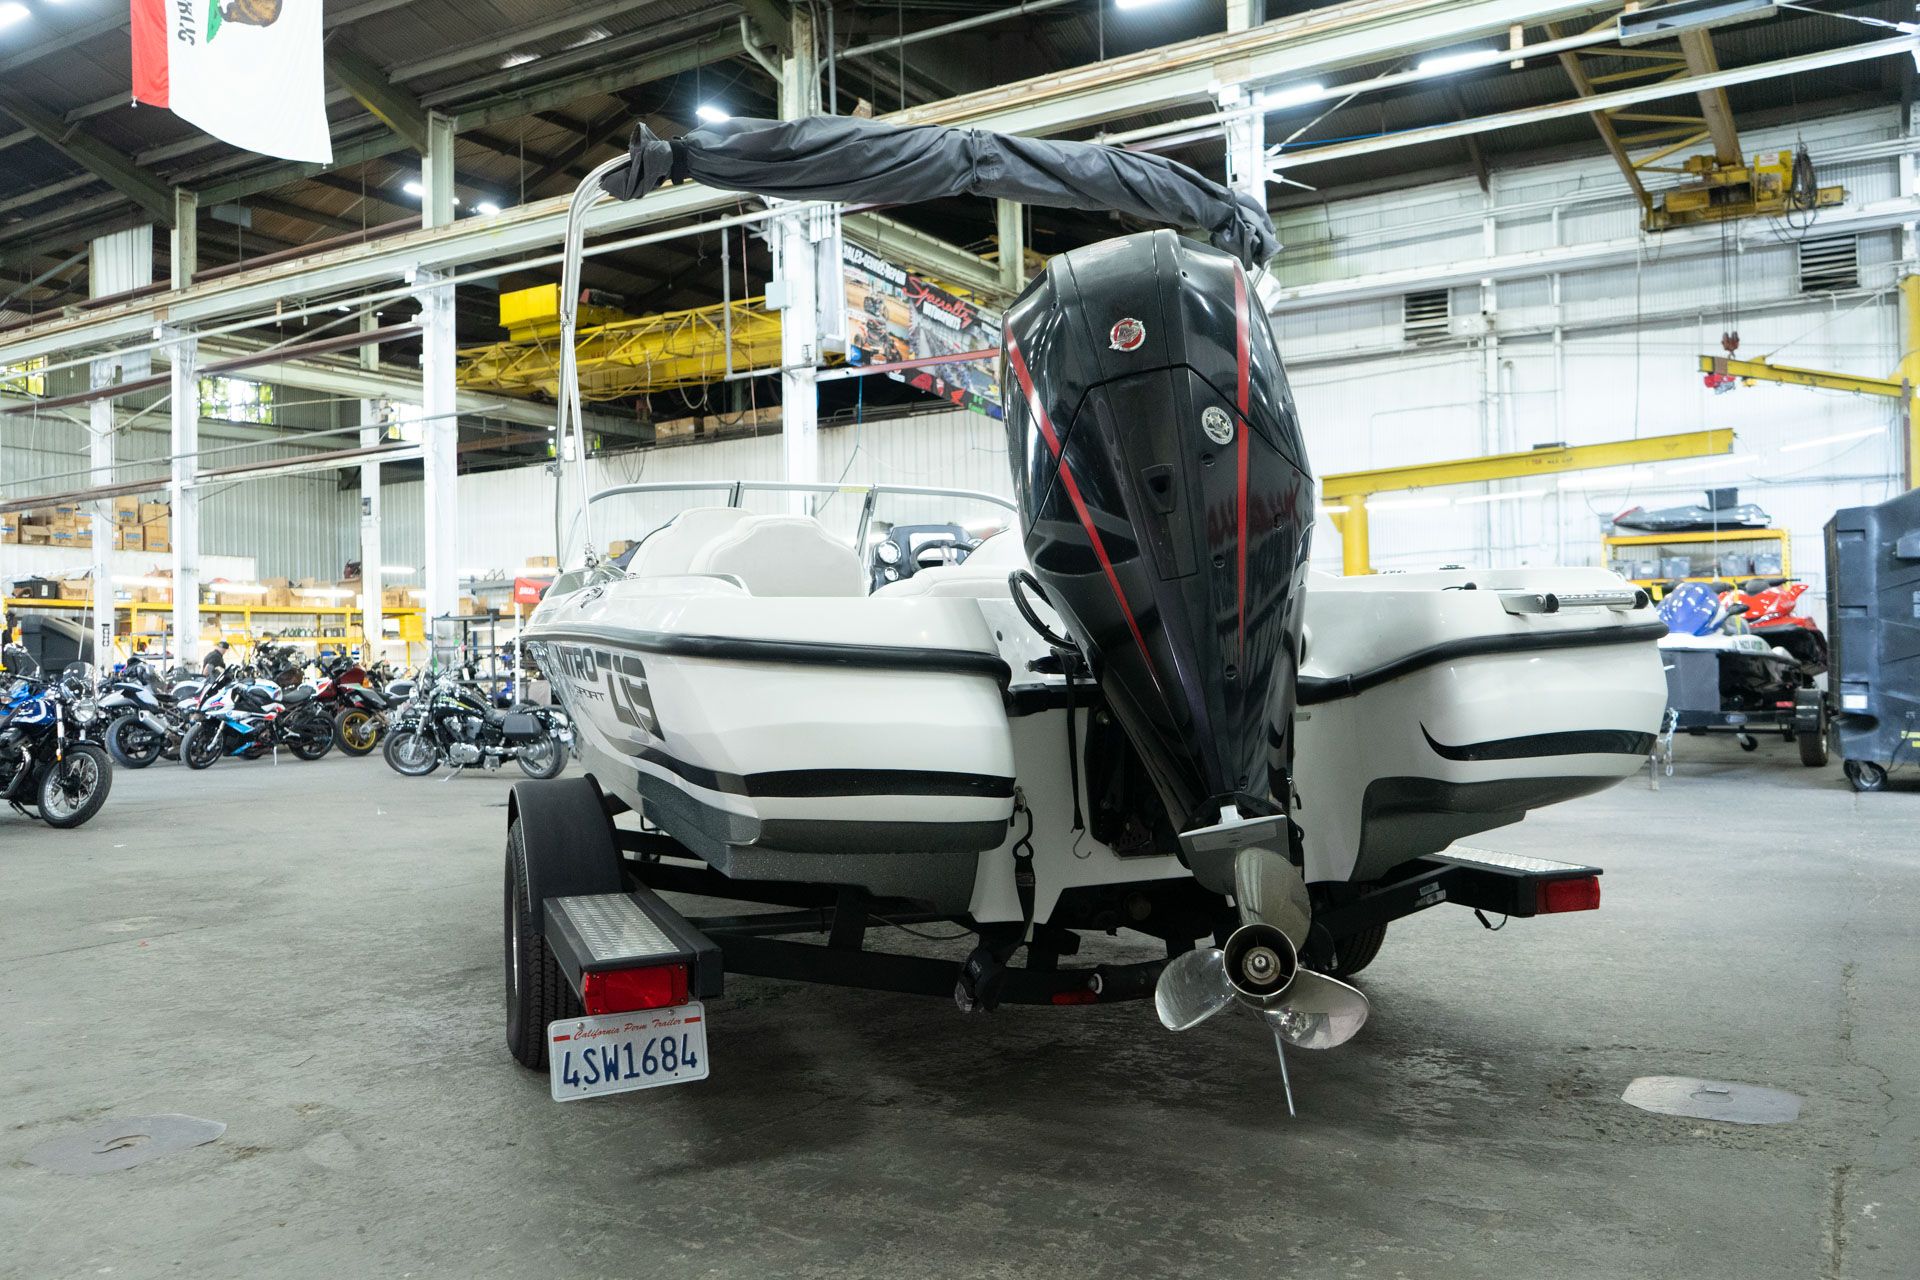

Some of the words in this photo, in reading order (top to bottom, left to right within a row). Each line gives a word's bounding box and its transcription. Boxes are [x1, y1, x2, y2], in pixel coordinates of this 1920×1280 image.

[573, 1027, 620, 1041] California
[623, 1022, 647, 1033] Perm
[651, 1017, 681, 1029] Trailer
[563, 1033, 697, 1087] 4SW1684
